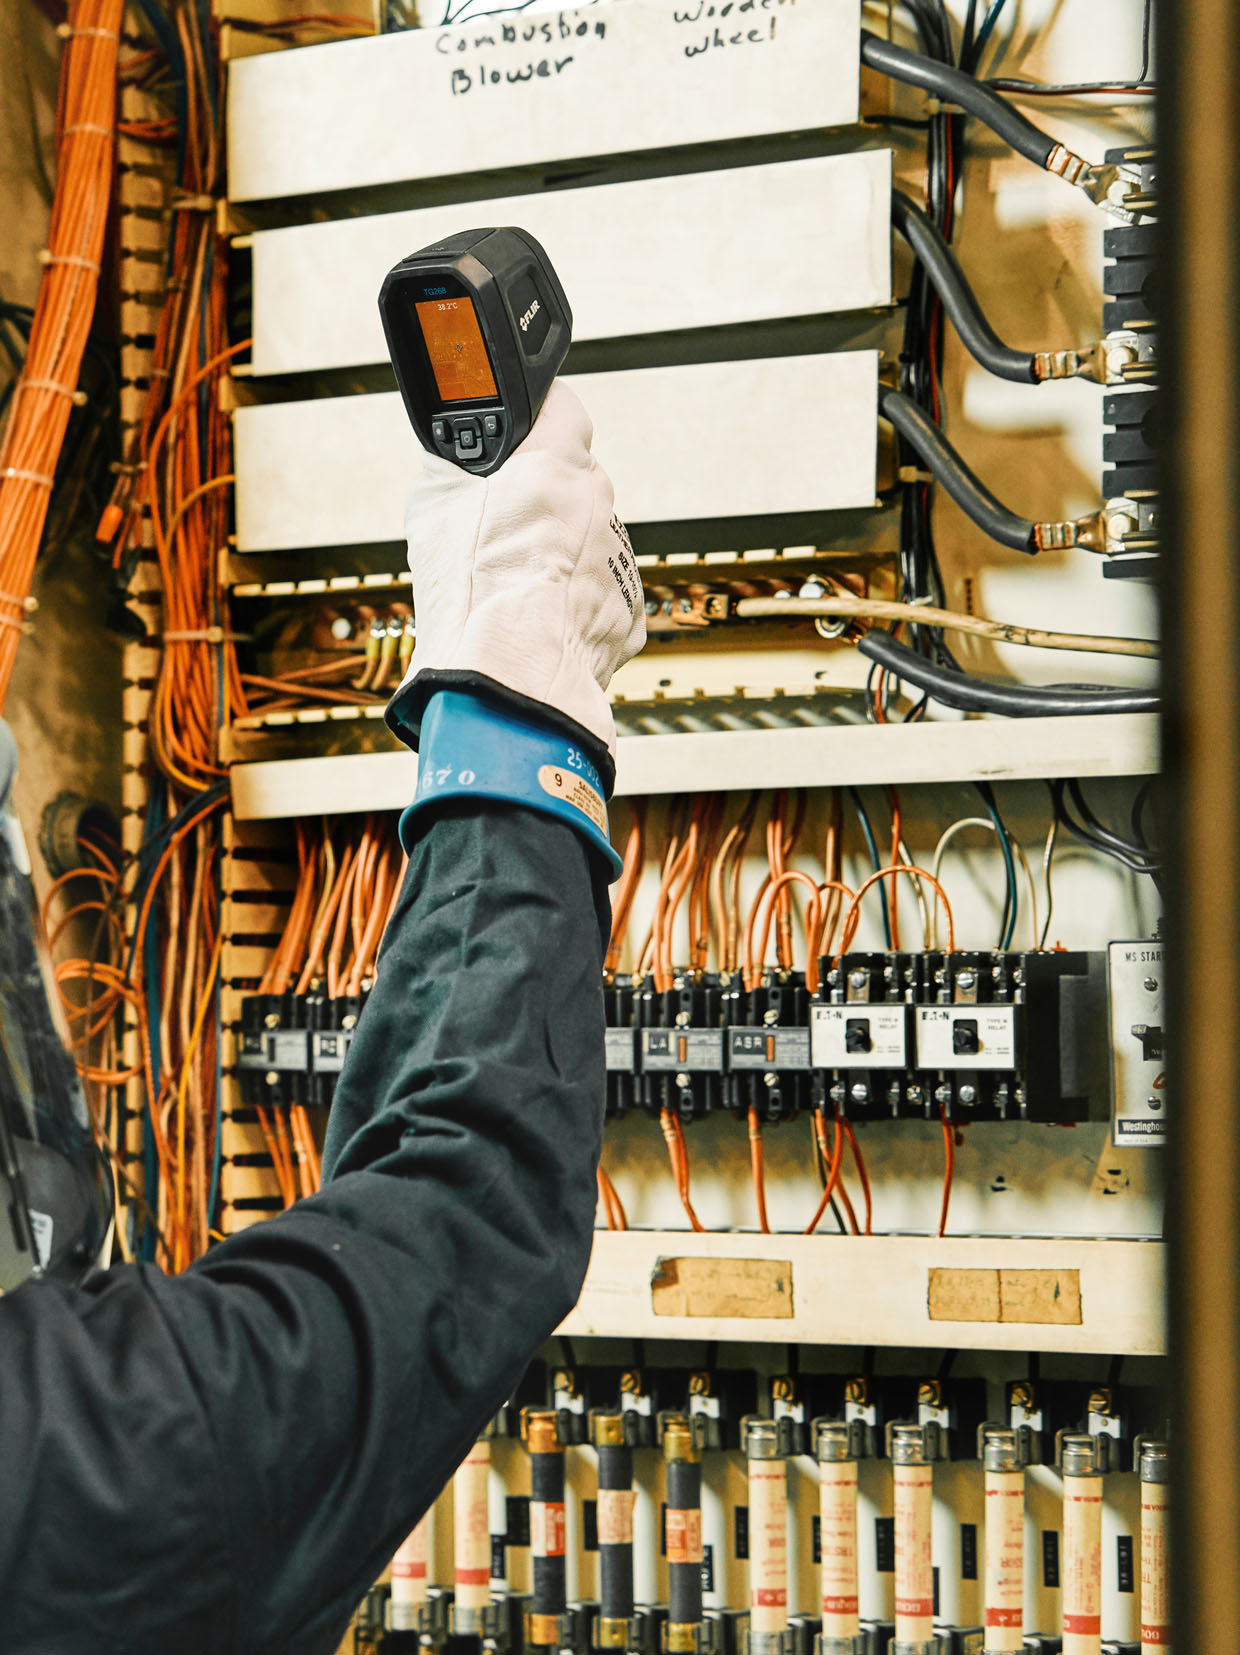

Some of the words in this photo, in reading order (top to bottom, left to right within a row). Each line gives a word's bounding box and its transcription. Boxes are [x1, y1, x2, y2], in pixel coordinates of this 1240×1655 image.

[436, 10, 607, 54] Combustion
[684, 16, 776, 58] wheel
[451, 56, 574, 95] Blower
[523, 299, 540, 325] FLIR
[612, 566, 626, 588] INCH
[554, 772, 563, 788] 9
[1125, 951, 1137, 962] MS
[649, 1034, 667, 1049] LA
[734, 1036, 763, 1049] ASR
